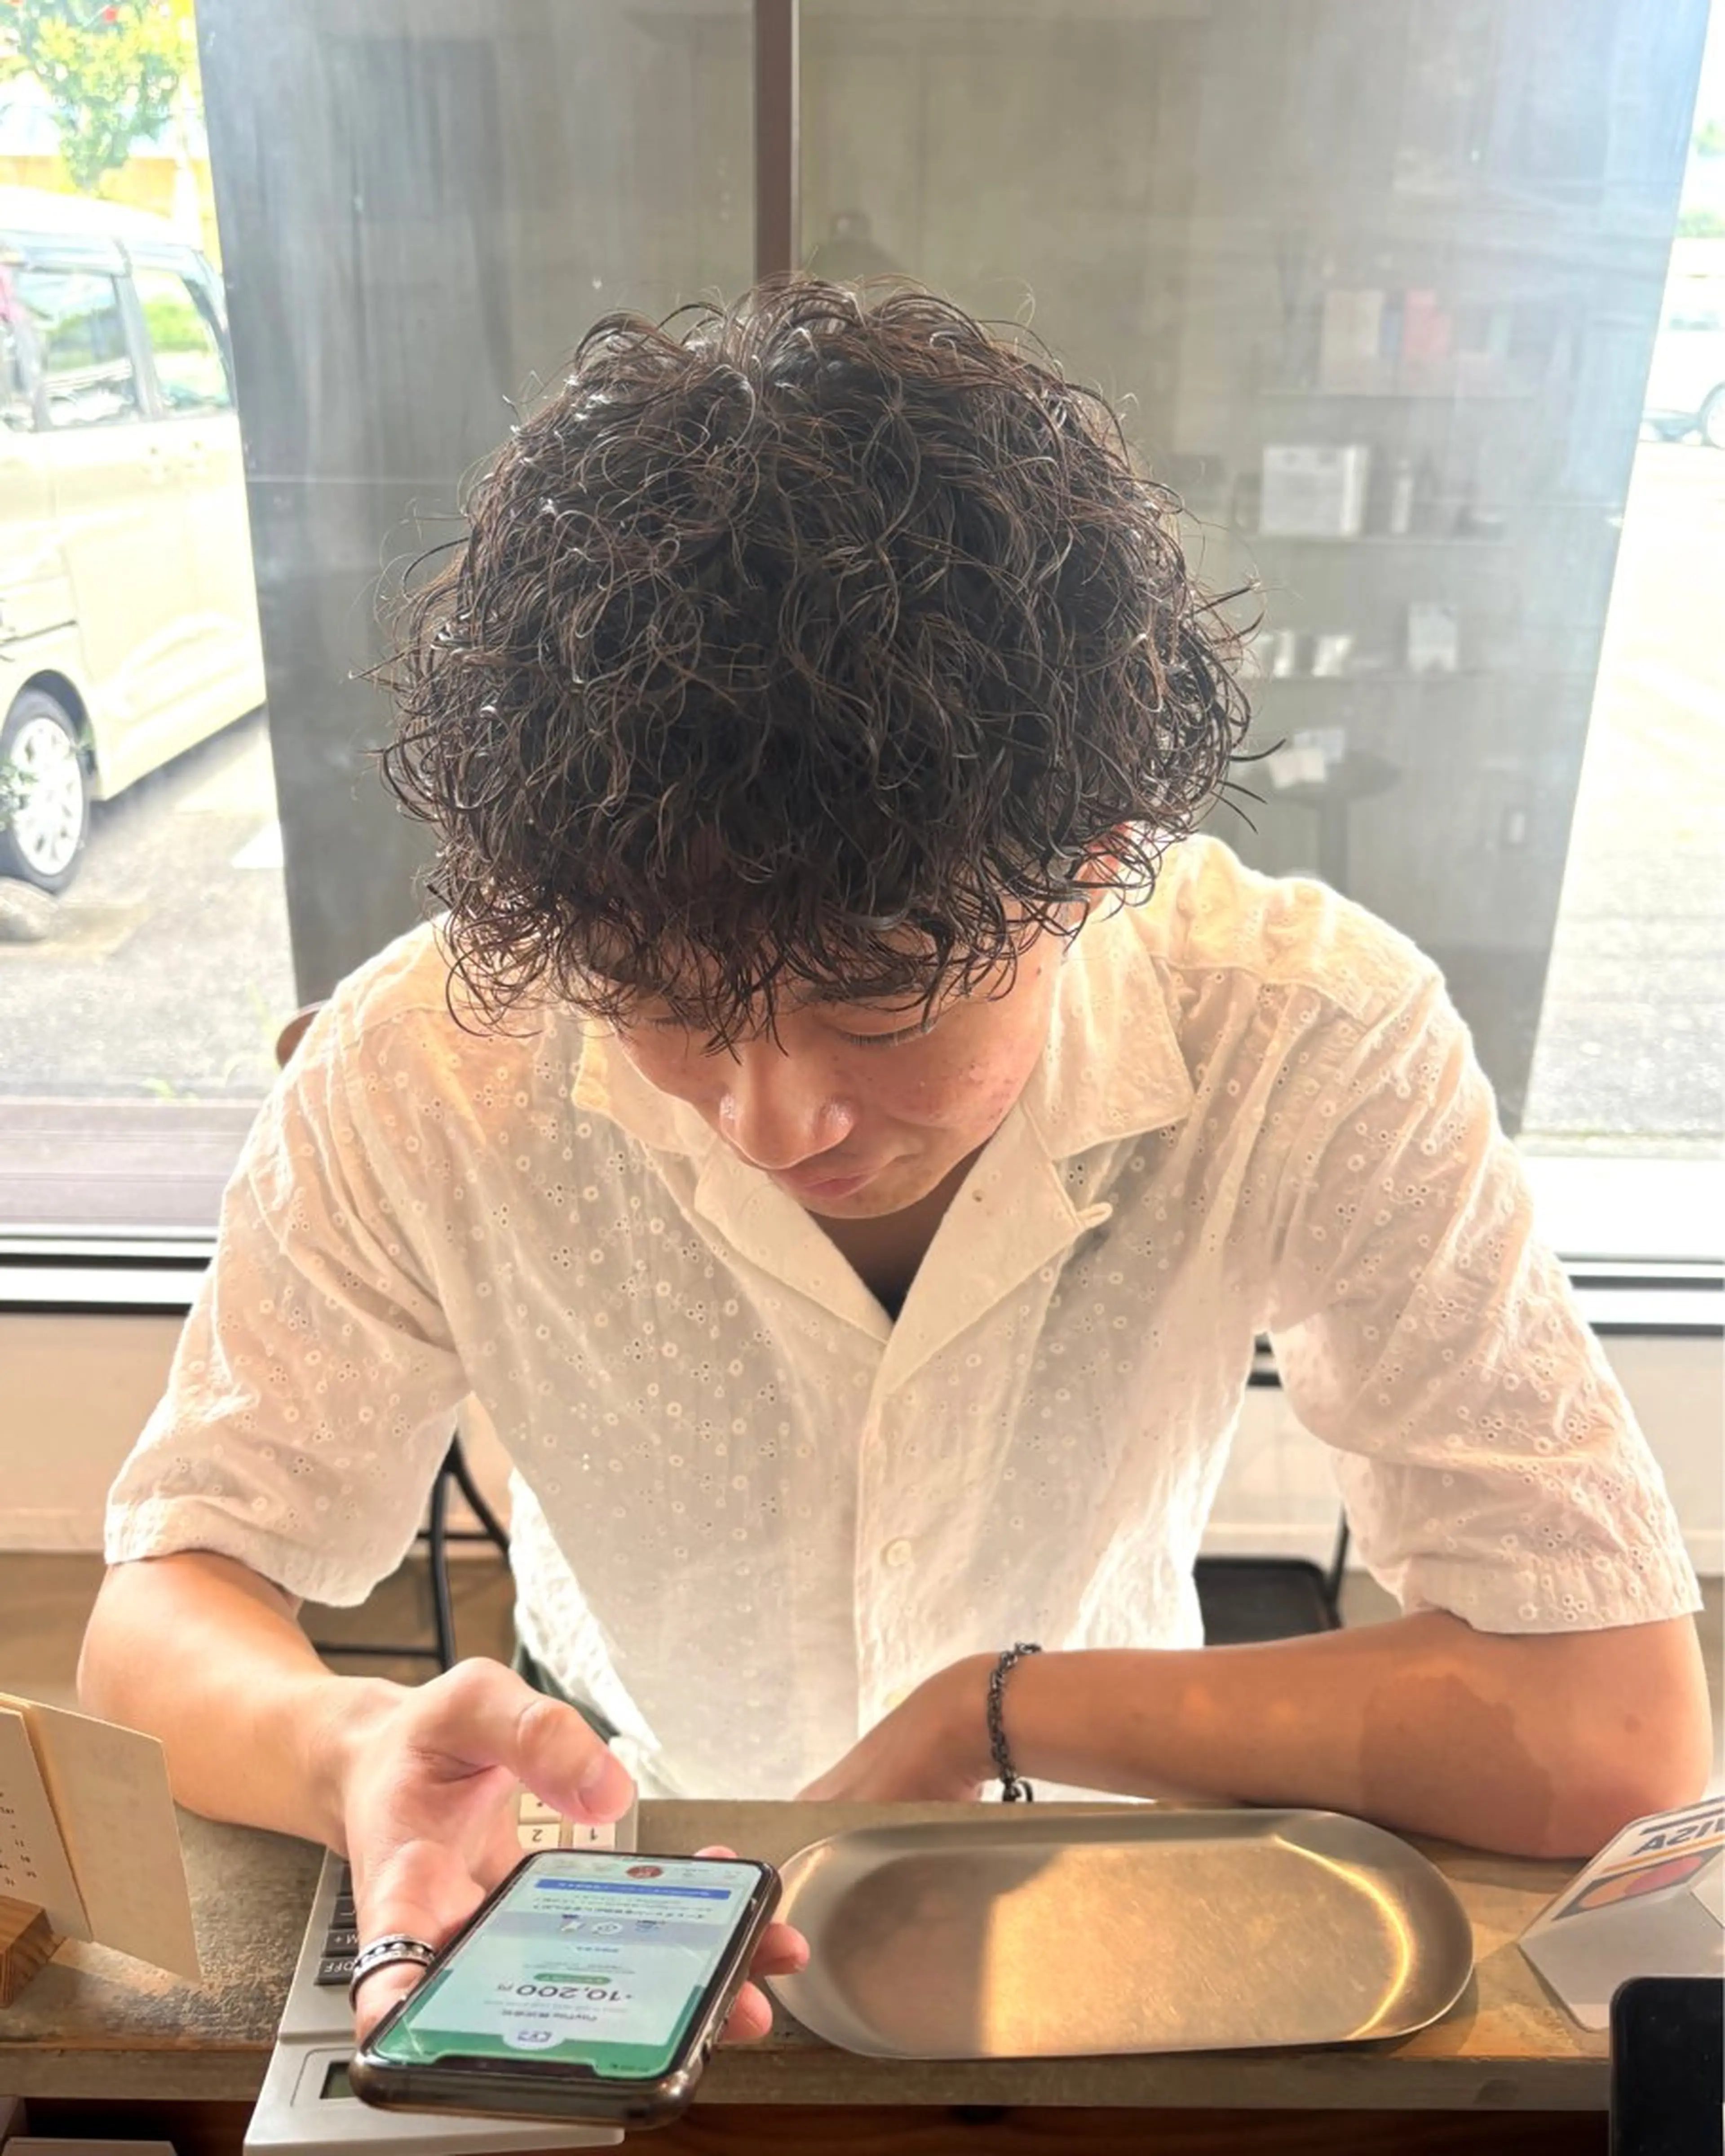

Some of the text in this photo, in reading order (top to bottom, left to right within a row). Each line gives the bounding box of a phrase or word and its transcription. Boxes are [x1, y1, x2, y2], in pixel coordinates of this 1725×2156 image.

[532, 1829, 543, 1842] 2
[591, 1827, 598, 1841] 1
[324, 1962, 354, 1973] OFF
